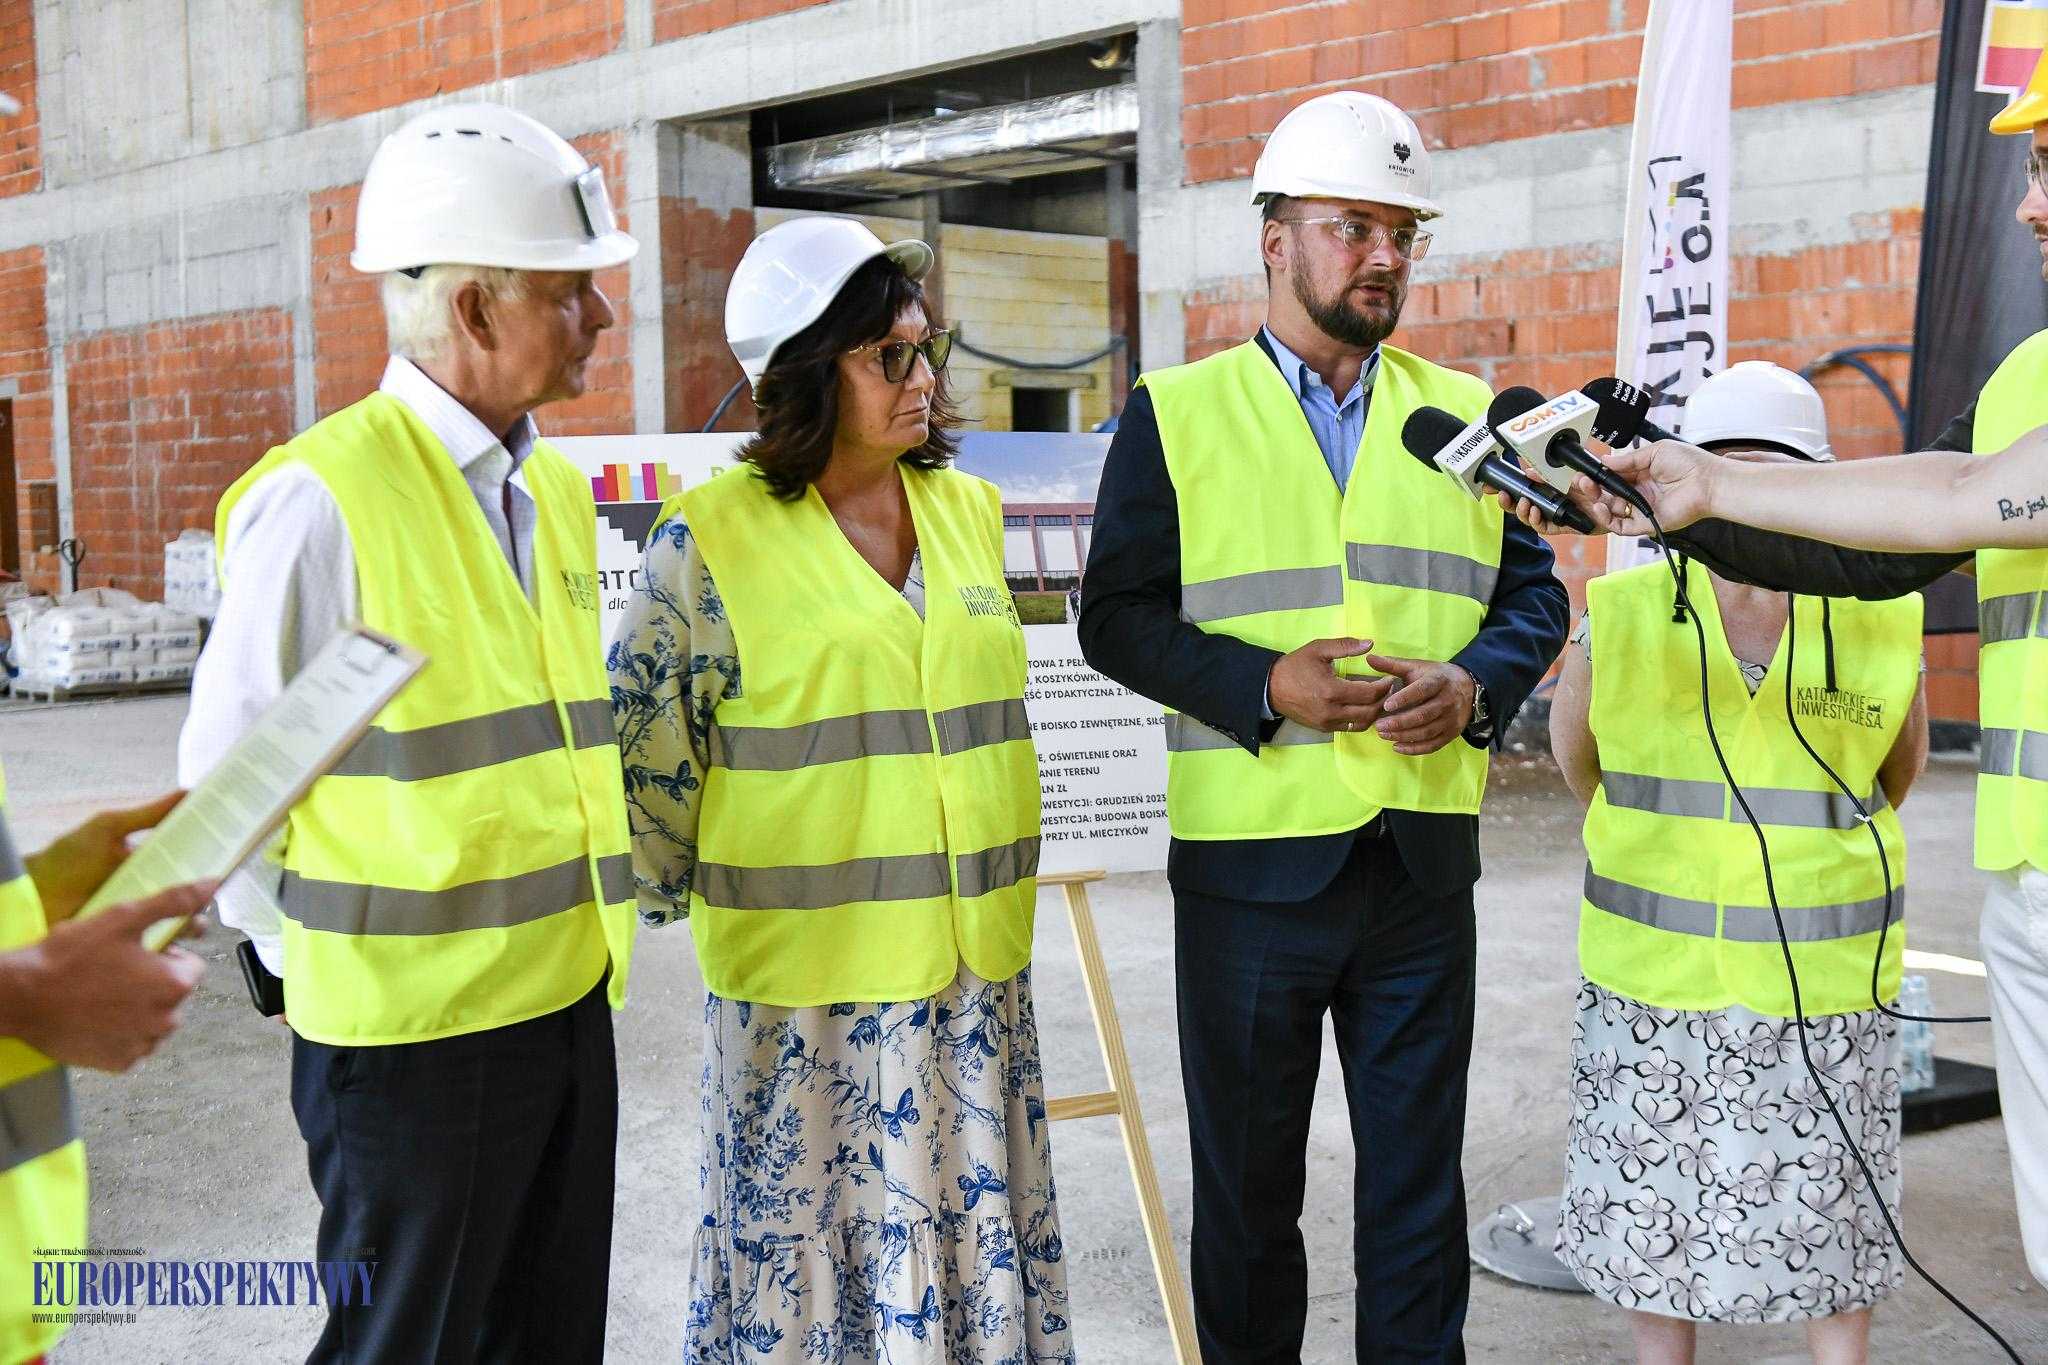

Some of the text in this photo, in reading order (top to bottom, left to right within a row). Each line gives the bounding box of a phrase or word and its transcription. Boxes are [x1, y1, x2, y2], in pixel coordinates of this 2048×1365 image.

[1035, 671, 1100, 684] KOSZYKÓWKI
[1044, 688, 1115, 699] DYDAKTYCZNA
[1796, 686, 1866, 711] KATOWICKIE
[1796, 700, 1865, 726] INWESTYCJE
[1041, 720, 1078, 731] BOISKO
[1080, 717, 1144, 730] ZEWNĘTRZNE,
[1049, 749, 1110, 762] OŚWIETLENIE
[1112, 748, 1138, 758] ORAZ
[1064, 766, 1100, 777] TERENU
[1040, 799, 1093, 810] WESTYCJI:
[1145, 793, 1167, 803] 2023
[1095, 811, 1138, 822] BUDOWA
[1046, 831, 1069, 842] PRZY
[1089, 824, 1149, 839] MIECZYKÓW
